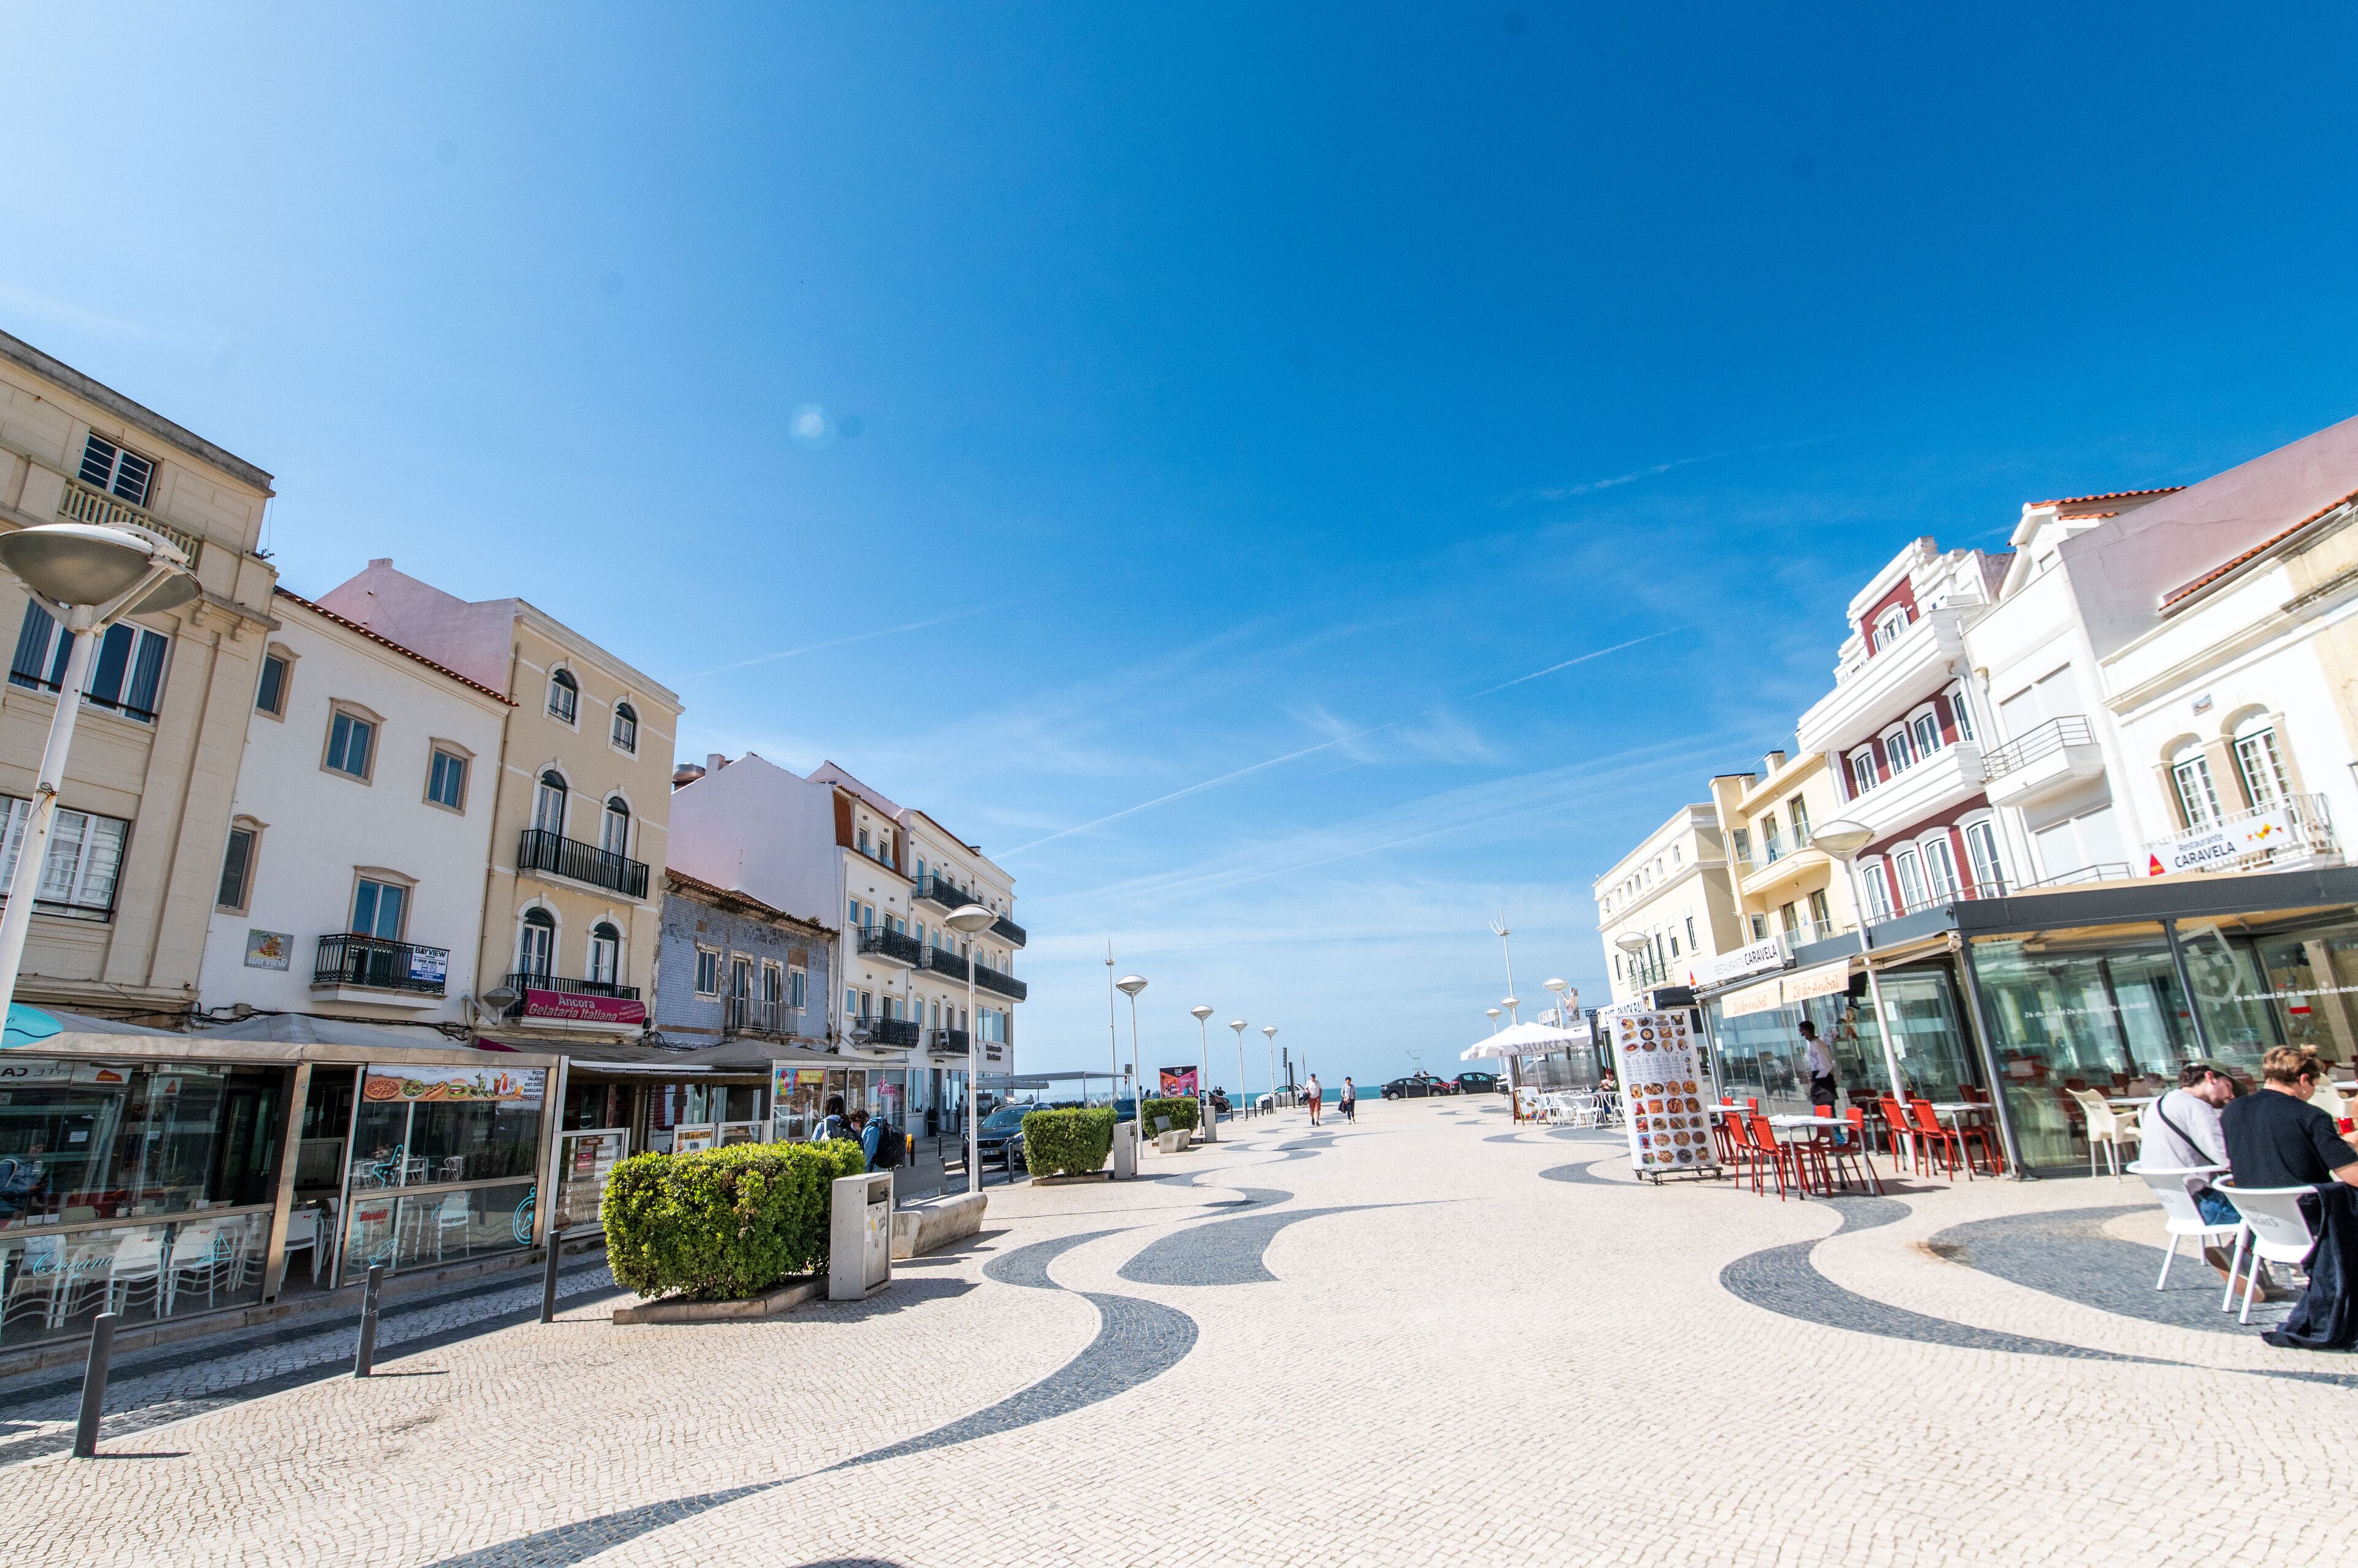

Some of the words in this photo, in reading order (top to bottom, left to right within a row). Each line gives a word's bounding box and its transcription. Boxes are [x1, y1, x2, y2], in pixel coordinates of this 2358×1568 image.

[2178, 833, 2223, 852] Restaurante
[2174, 842, 2236, 868] CARAVELA
[414, 947, 446, 958] BAYVIEW
[1745, 944, 1778, 966] CARAVELA
[248, 958, 287, 968] BAYVIEW
[528, 1003, 578, 1019] Gelataria
[580, 1008, 618, 1022] Italiana
[679, 1132, 690, 1141] FIERA
